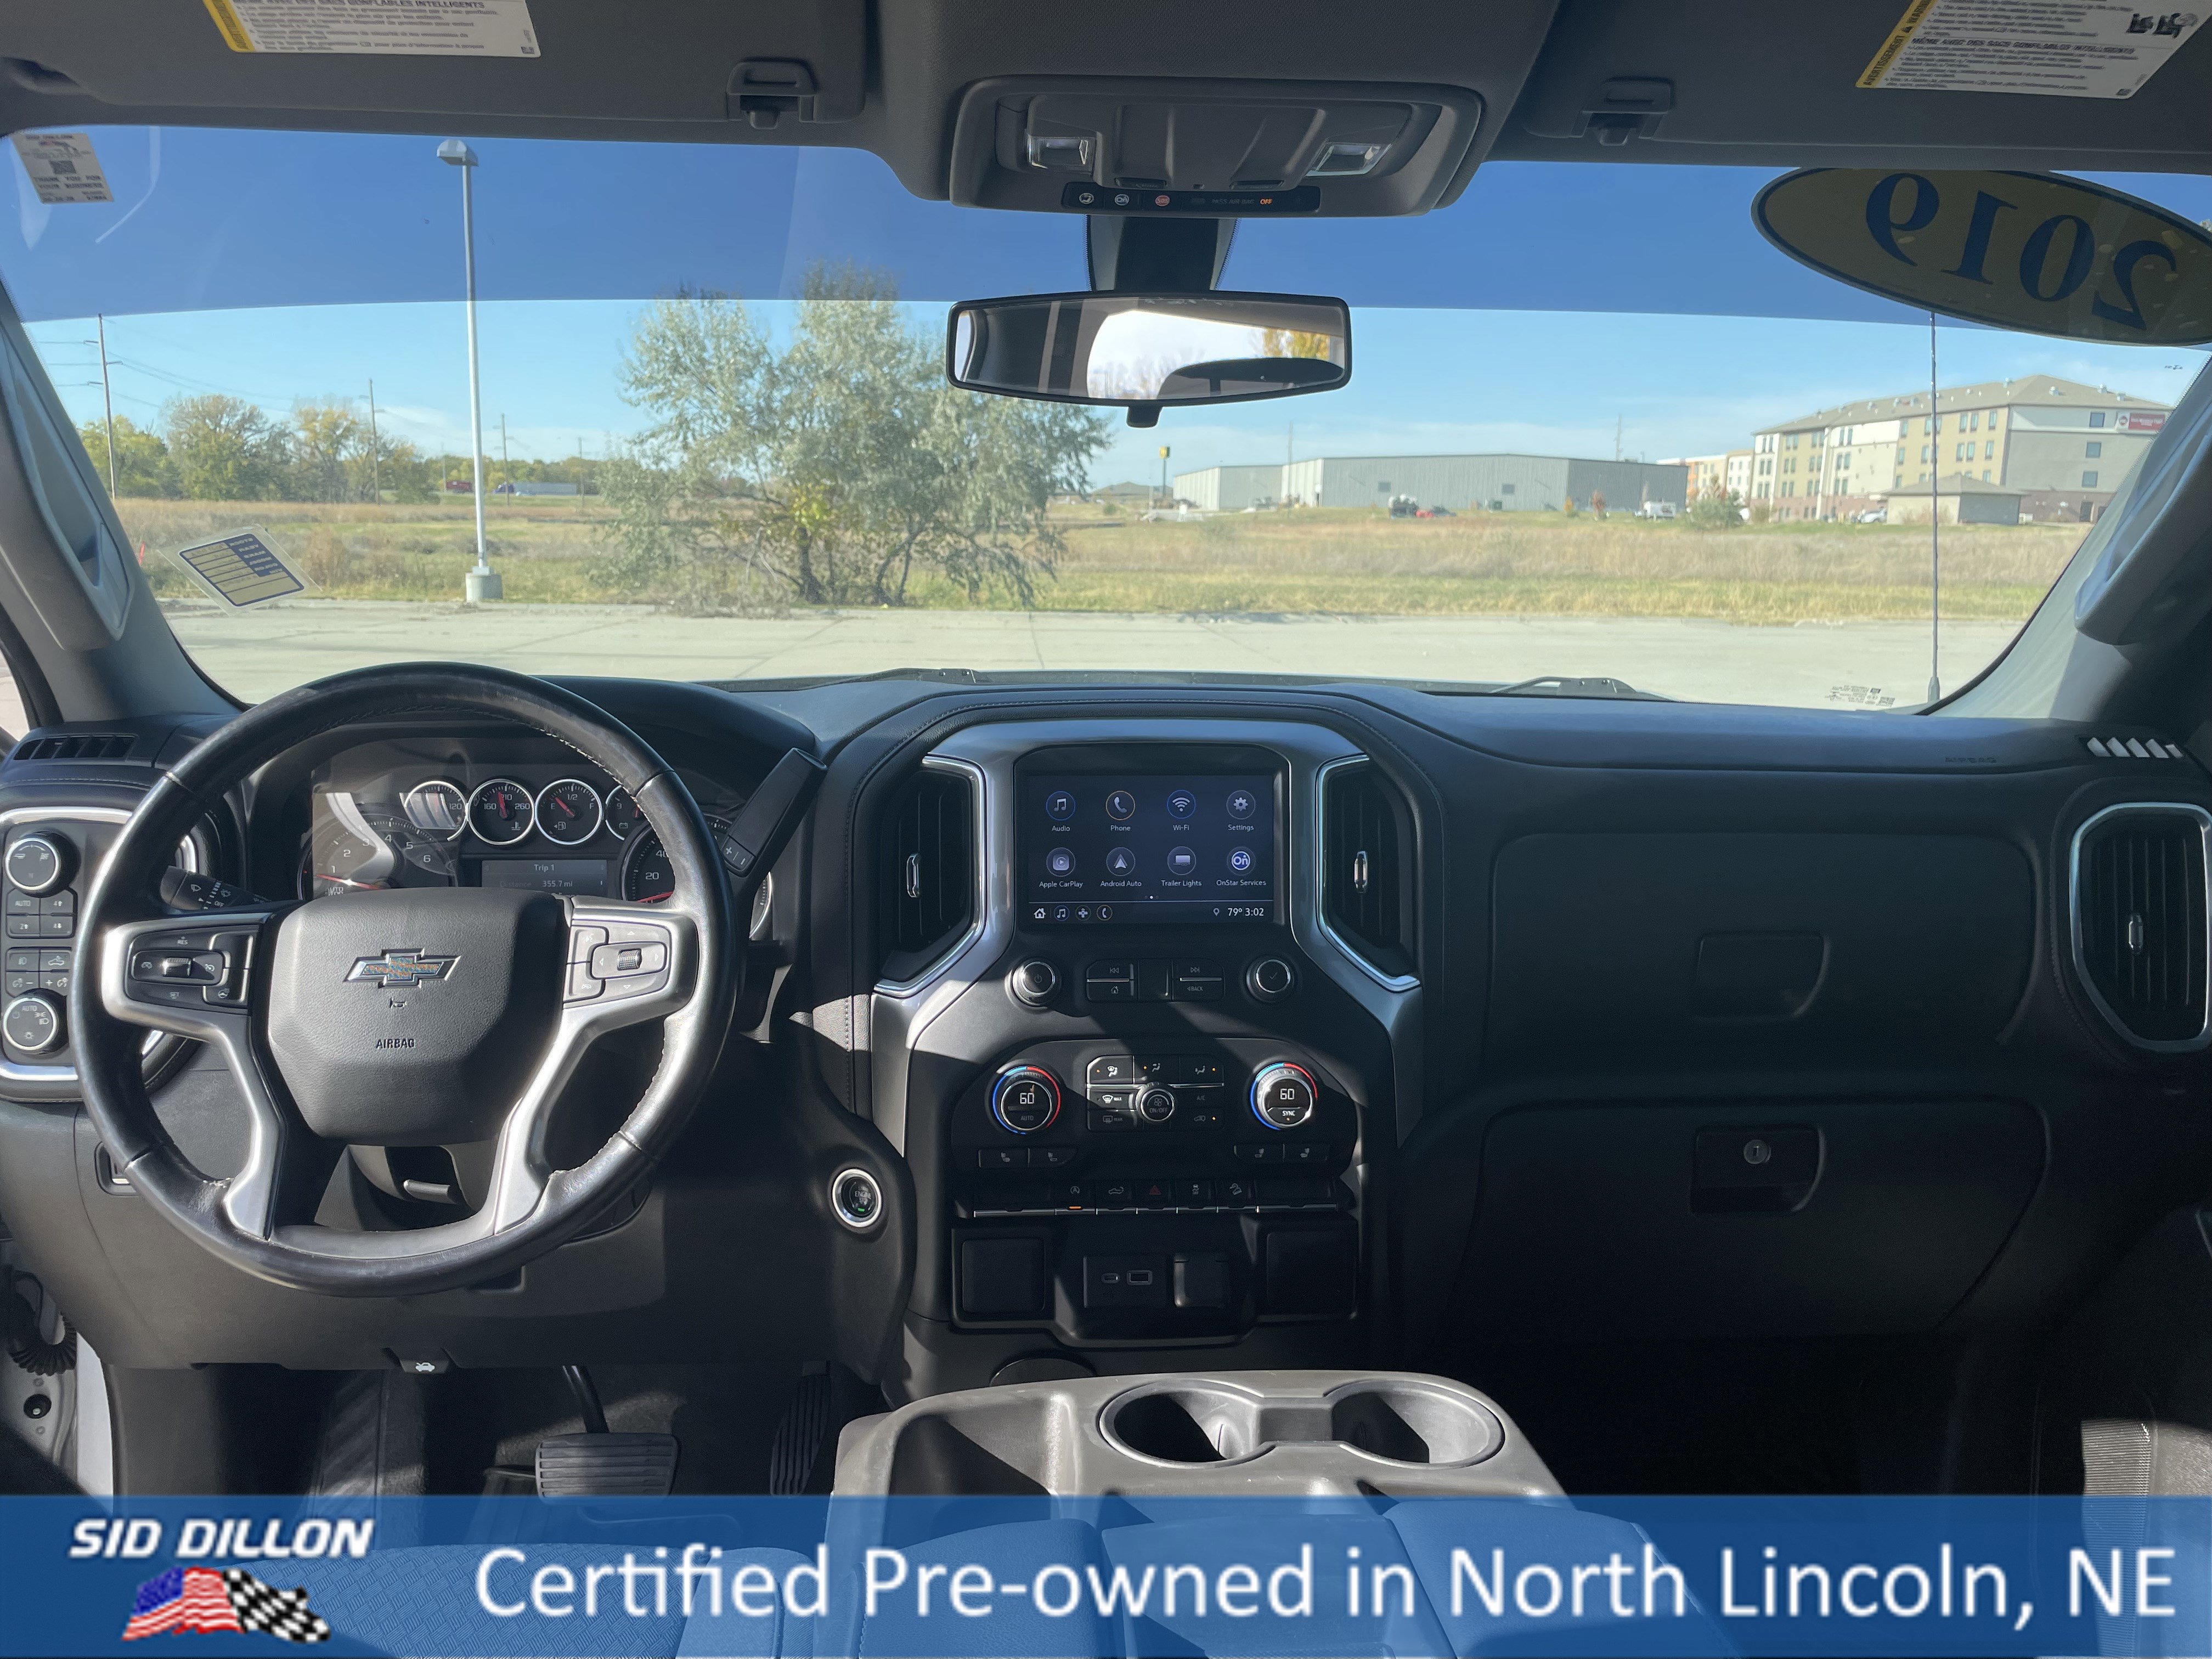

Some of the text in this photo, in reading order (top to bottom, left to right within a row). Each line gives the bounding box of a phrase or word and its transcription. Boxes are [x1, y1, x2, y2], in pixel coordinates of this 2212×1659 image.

[534, 864, 549, 872] Trip
[645, 872, 659, 880] 20
[1182, 879, 1202, 888] Lights
[1245, 907, 1264, 917] 3:02
[375, 1038, 416, 1049] AIRBAG
[1020, 1092, 1035, 1104] 60
[1280, 1088, 1295, 1100] 60
